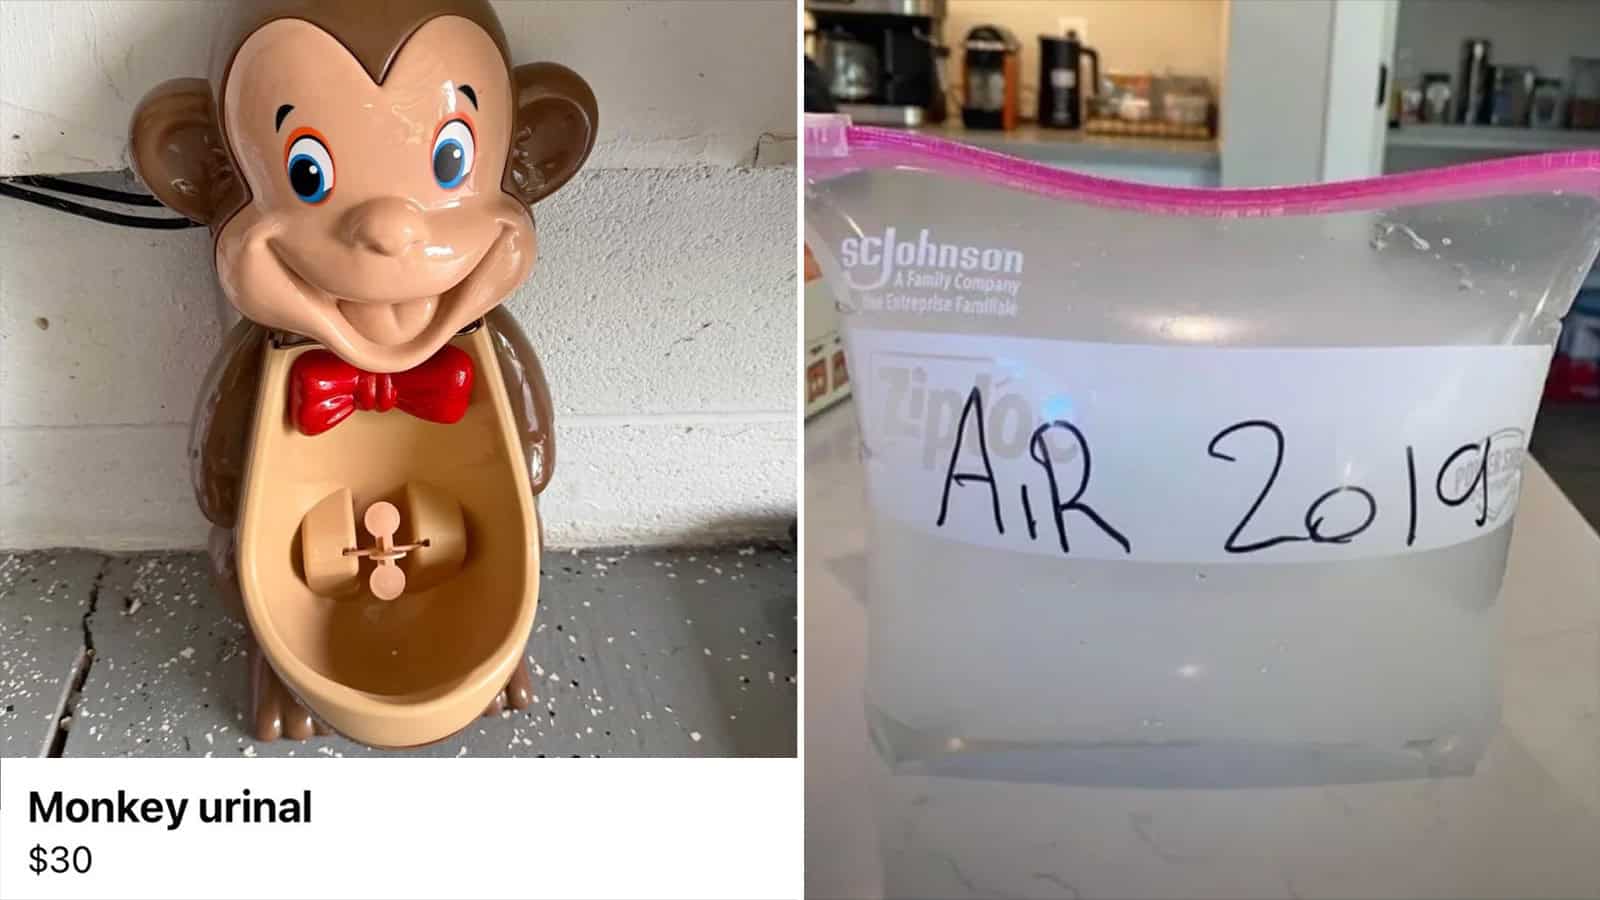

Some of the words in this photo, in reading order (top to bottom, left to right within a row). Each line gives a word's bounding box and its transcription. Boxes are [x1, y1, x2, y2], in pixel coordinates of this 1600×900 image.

[895, 271, 904, 287] A
[906, 272, 950, 289] Family
[954, 272, 1022, 296] Company
[1208, 419, 1490, 553] 2019
